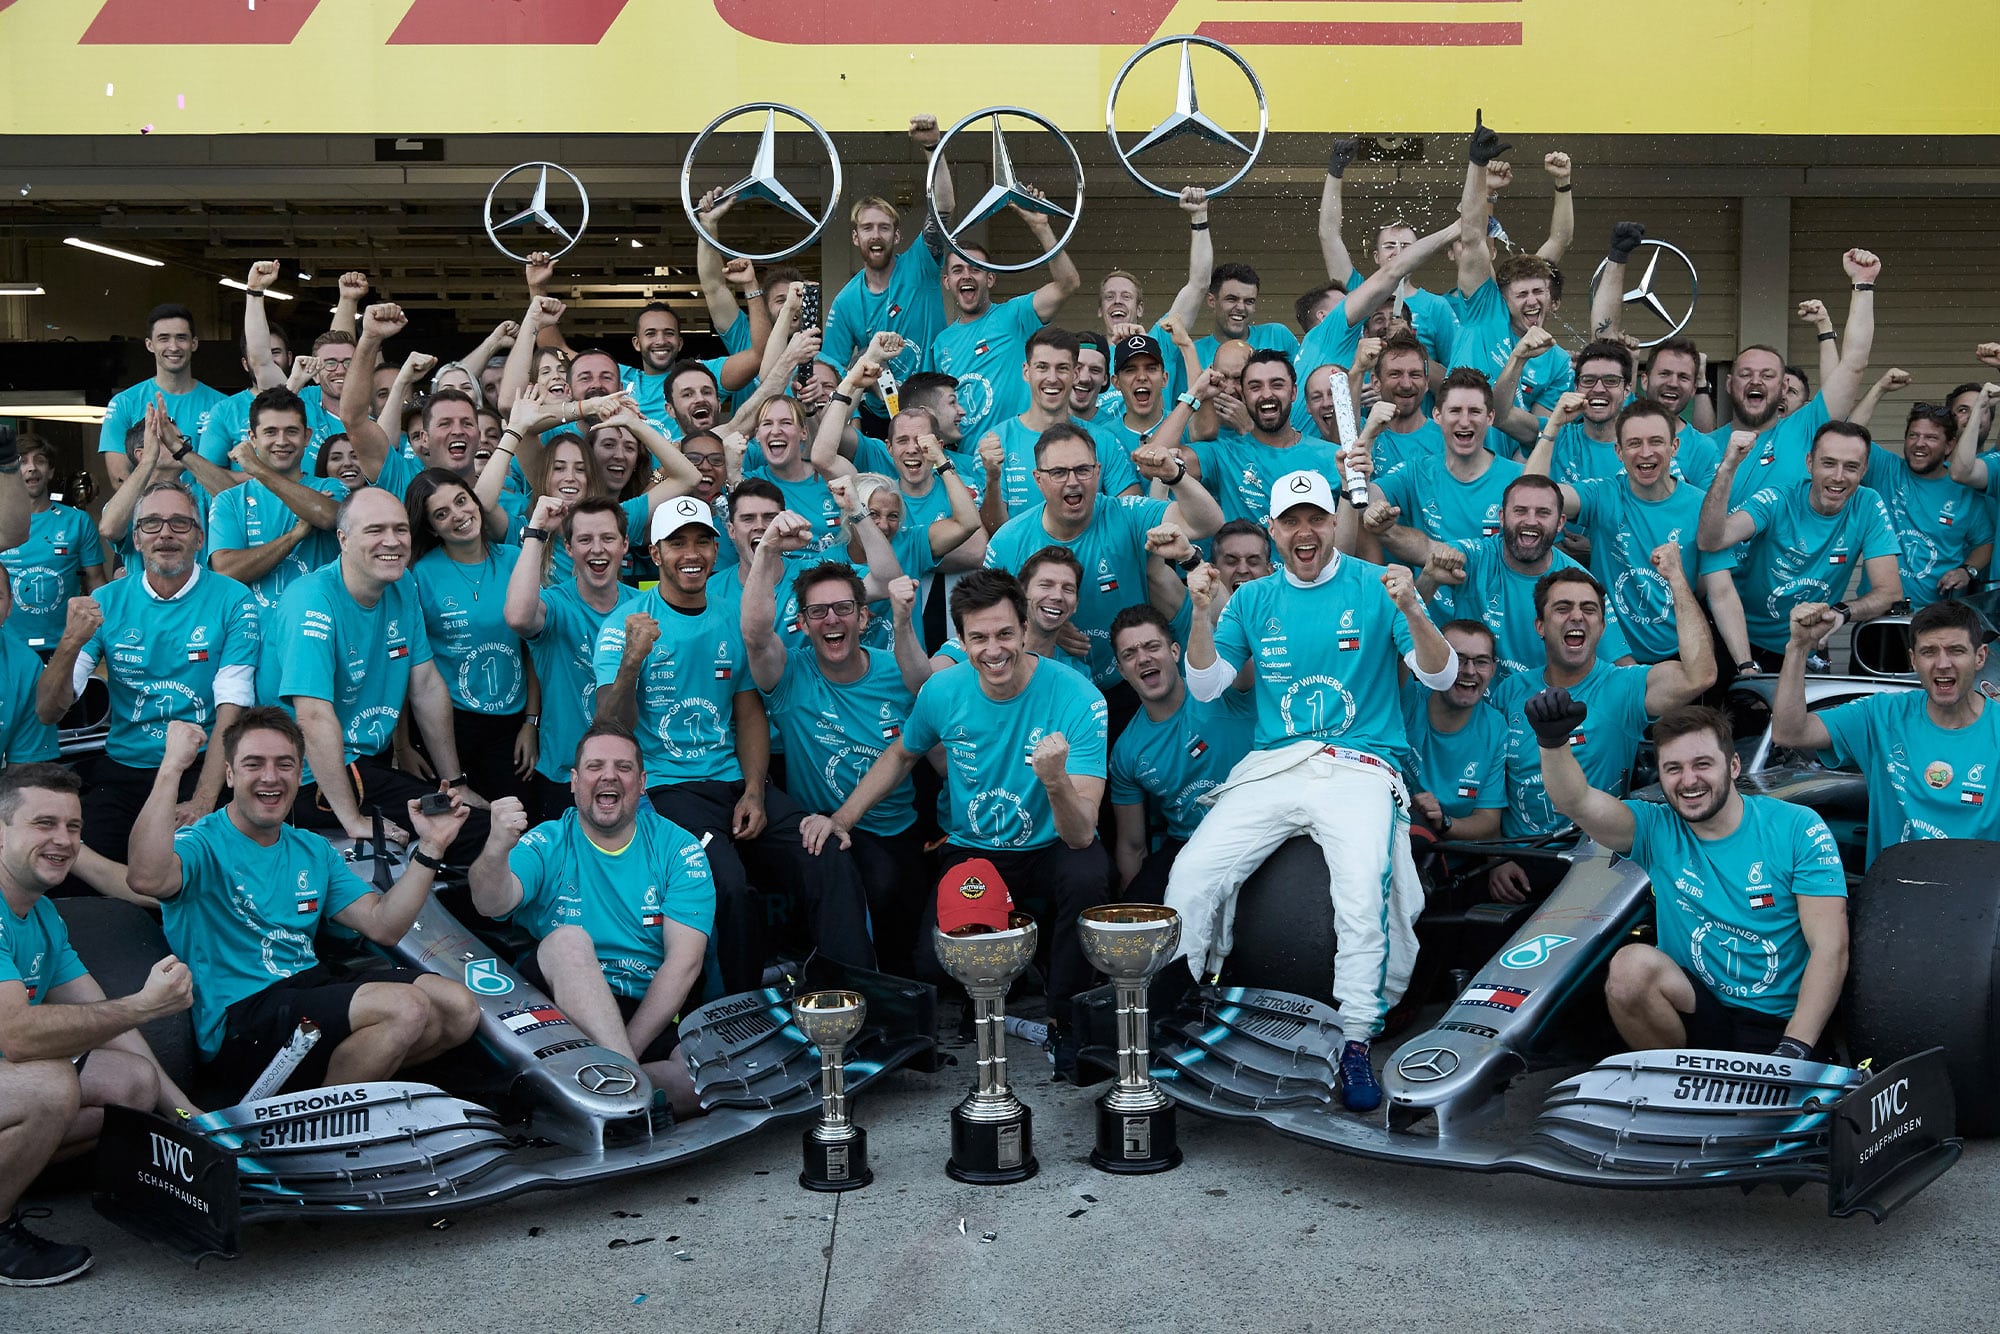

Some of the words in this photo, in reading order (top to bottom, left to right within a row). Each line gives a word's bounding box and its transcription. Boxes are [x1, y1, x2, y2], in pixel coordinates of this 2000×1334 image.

[31, 575, 45, 603] 1
[1785, 580, 1797, 592] GP
[31, 606, 50, 614] 2019
[305, 610, 332, 623] EPSON
[1629, 613, 1651, 625] 2019
[451, 619, 469, 628] UBS
[124, 654, 142, 664] UBS
[466, 651, 480, 662] GP
[477, 643, 515, 656] WINNERS
[1272, 647, 1288, 656] UBS
[1259, 661, 1292, 669] Qualcomm
[481, 656, 498, 696] 1
[657, 672, 675, 680] UBS
[1288, 680, 1302, 695] GP
[1300, 675, 1343, 692] WINNERS
[150, 680, 196, 699] WINNERS
[482, 701, 504, 712] 2019
[669, 703, 682, 717] GP
[681, 697, 719, 716] WINNERS
[1306, 690, 1324, 731] 1
[350, 716, 363, 732] GP
[360, 706, 401, 723] WINNERS
[838, 746, 852, 758] GP
[851, 746, 884, 760] WINNE
[959, 751, 977, 760] UBS
[976, 791, 988, 802] GP
[1181, 780, 1216, 798] WINNERS
[1684, 882, 1704, 898] UBS
[1718, 936, 1740, 980] 1
[1477, 983, 1526, 995] TOMMY
[1719, 982, 1748, 997] 2019
[502, 1004, 551, 1018] TOMMY
[704, 997, 759, 1022] PETRONAS
[1251, 994, 1315, 1016] PETRONAS
[1460, 1000, 1512, 1011] HILFIGER
[518, 1018, 568, 1034] HILFIGER
[1437, 1021, 1499, 1039] PIRELLI
[1675, 1054, 1792, 1077] PETRONAS
[1673, 1075, 1791, 1106] SYNTIUM
[254, 1089, 369, 1120] PETRONAS
[1870, 1078, 1909, 1133] IWC
[259, 1108, 370, 1149] SYNTIUM
[1859, 1116, 1922, 1164] SCHAFFHAUSEN
[150, 1133, 195, 1183] IWC
[828, 1163, 846, 1176] 3
[138, 1170, 209, 1214] SCHAFFHAUSEN
